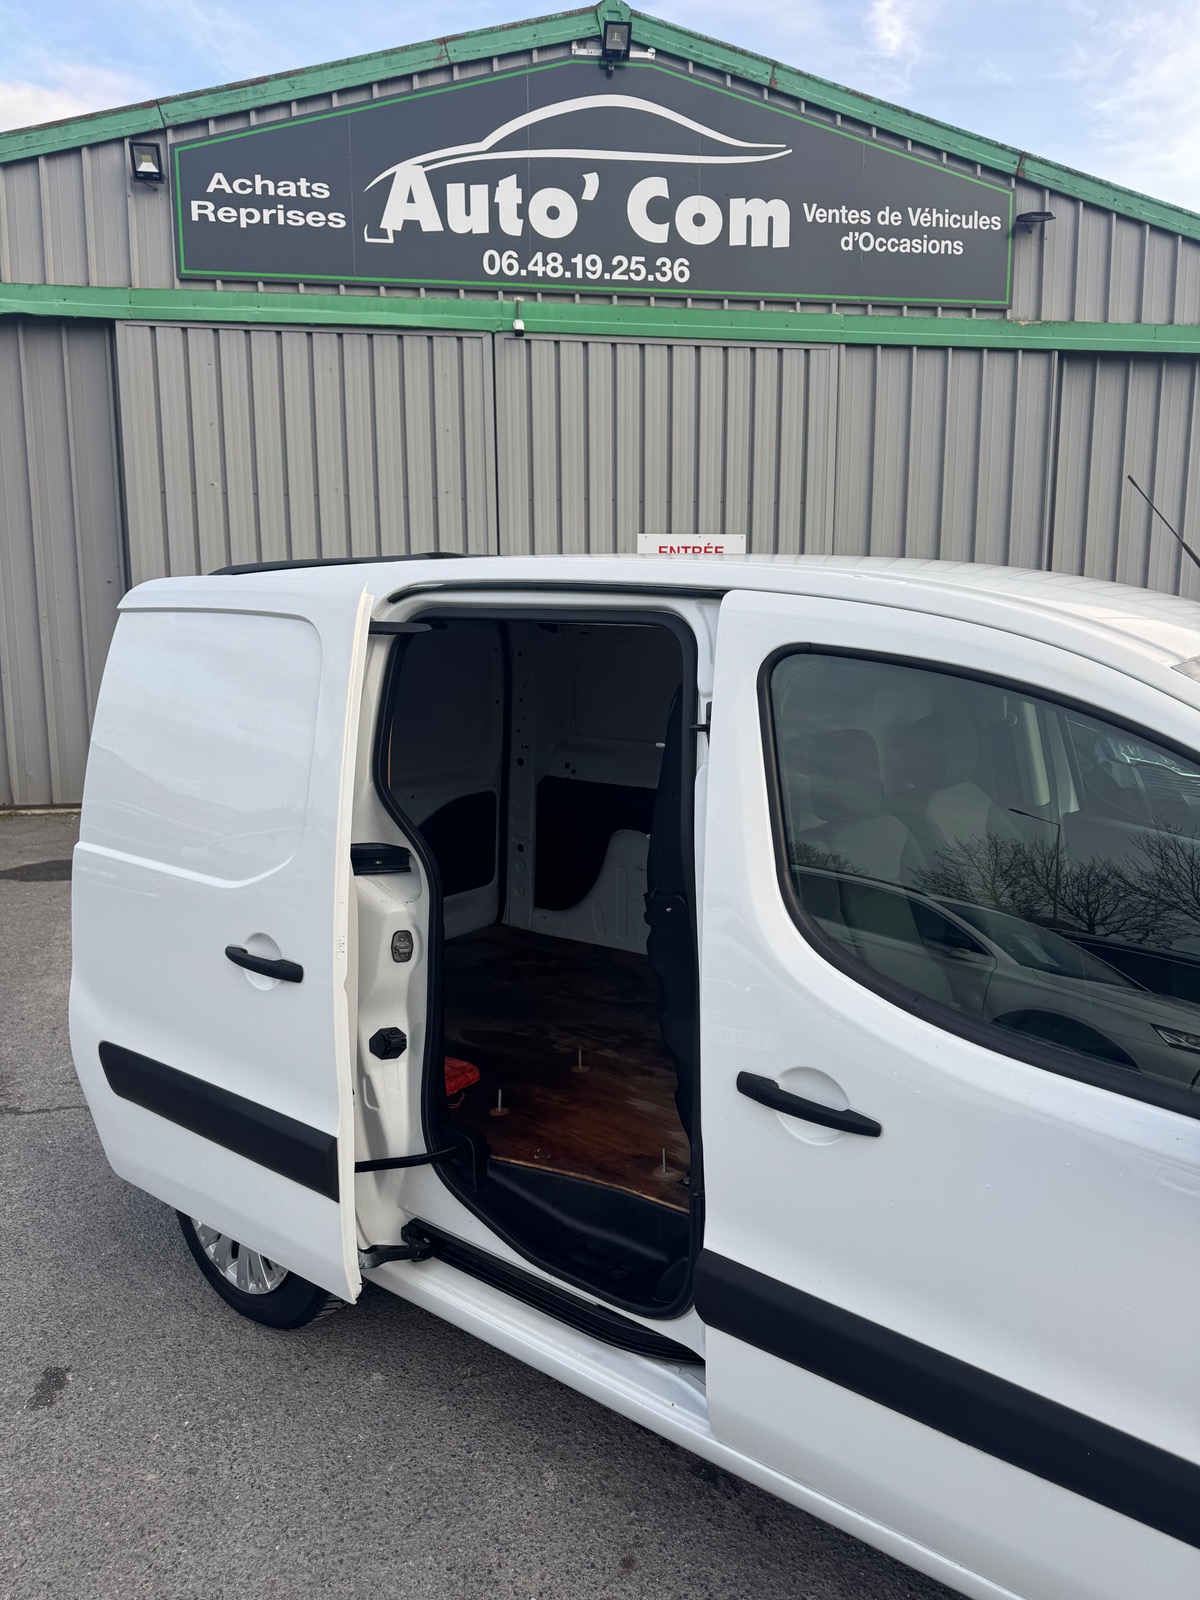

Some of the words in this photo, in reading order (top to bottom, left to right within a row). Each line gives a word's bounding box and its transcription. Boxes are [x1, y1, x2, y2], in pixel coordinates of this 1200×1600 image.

[206, 172, 331, 199] Achats
[190, 200, 347, 229] Reprises
[626, 176, 791, 249] Com
[802, 202, 872, 226] Ventes
[876, 205, 903, 226] de
[907, 207, 1002, 231] Véhicules
[840, 231, 965, 256] d'Occasions
[482, 249, 691, 283] 06.48.19.25.36
